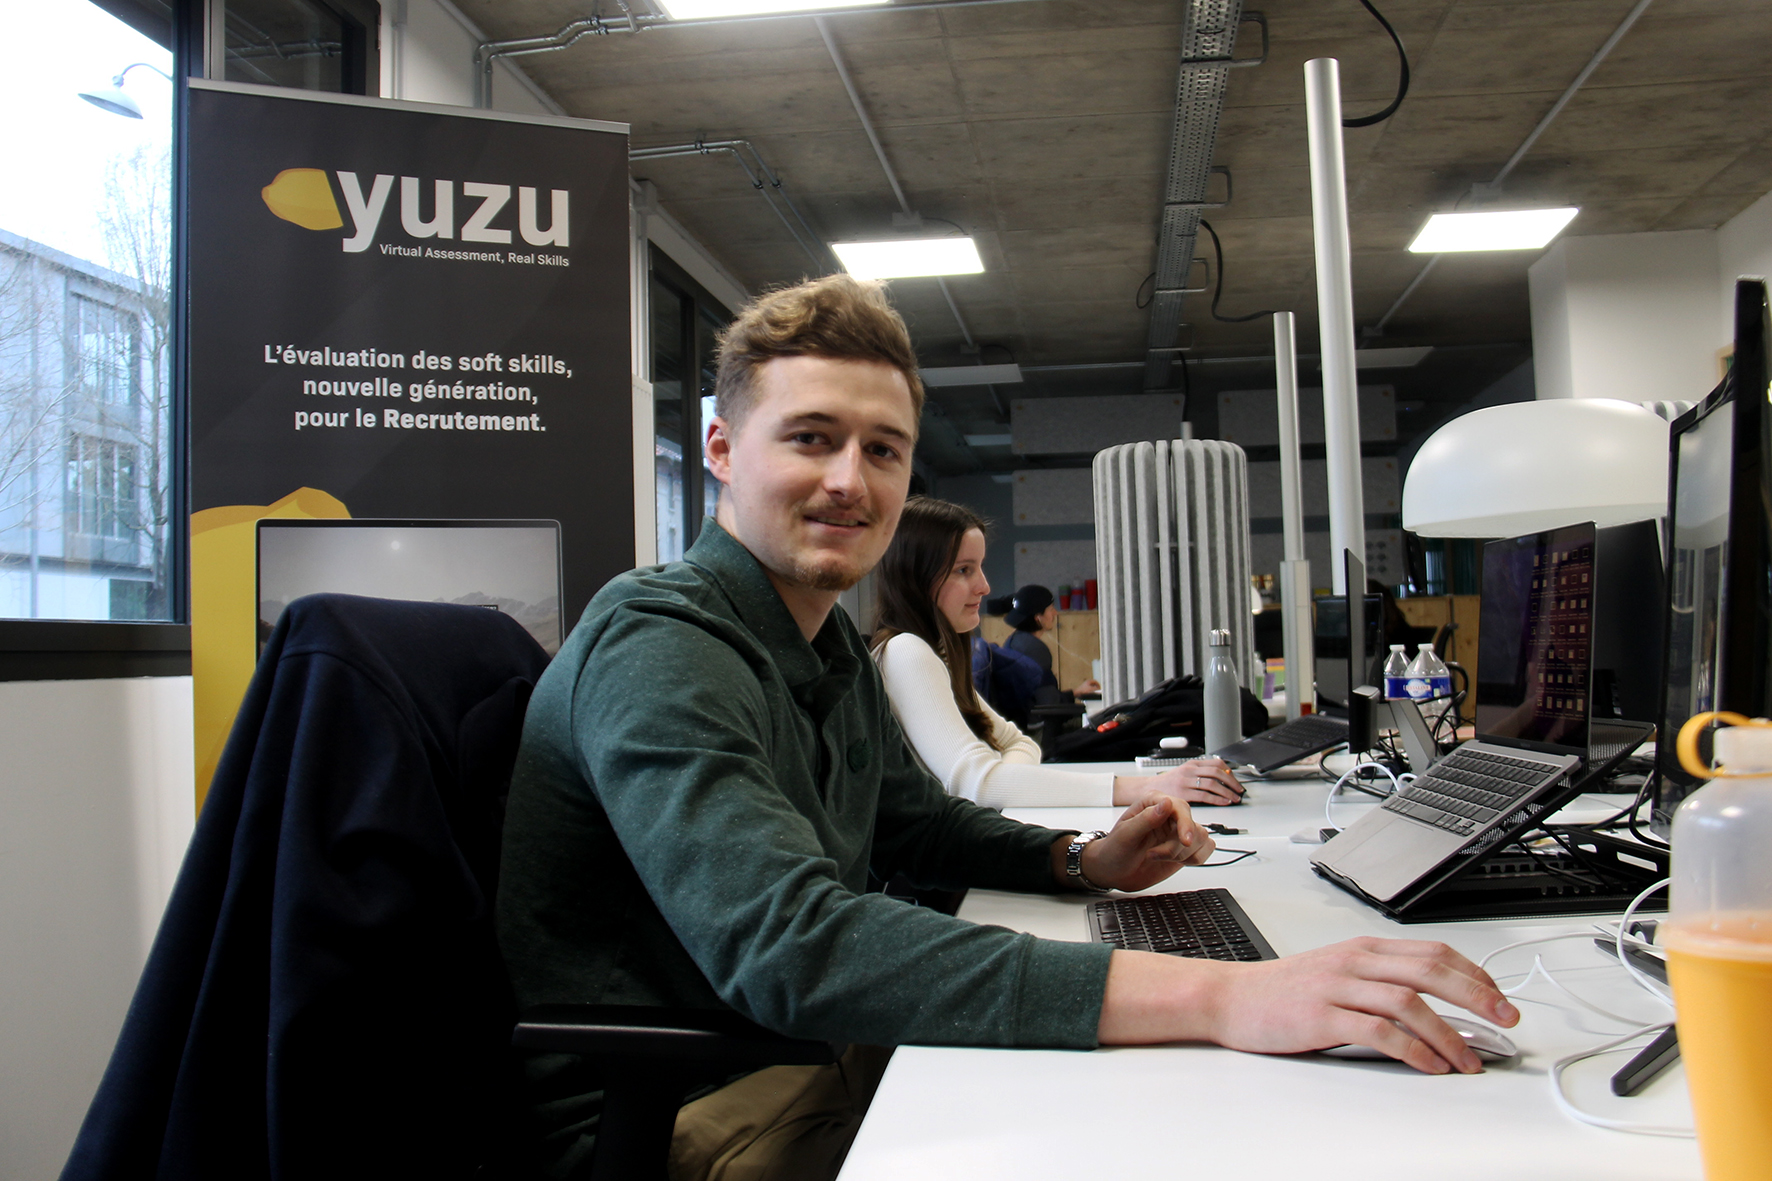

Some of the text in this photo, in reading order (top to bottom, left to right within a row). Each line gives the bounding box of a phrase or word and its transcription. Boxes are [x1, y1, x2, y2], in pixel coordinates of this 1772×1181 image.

[336, 170, 570, 253] yuzu
[379, 243, 570, 267] Virtual Assessment, Real Skills
[411, 350, 453, 371] des
[458, 352, 503, 372] soft
[508, 353, 573, 379] skills,
[303, 377, 538, 406] nouvelle génération,
[294, 407, 546, 432] pour le Recrutement.
